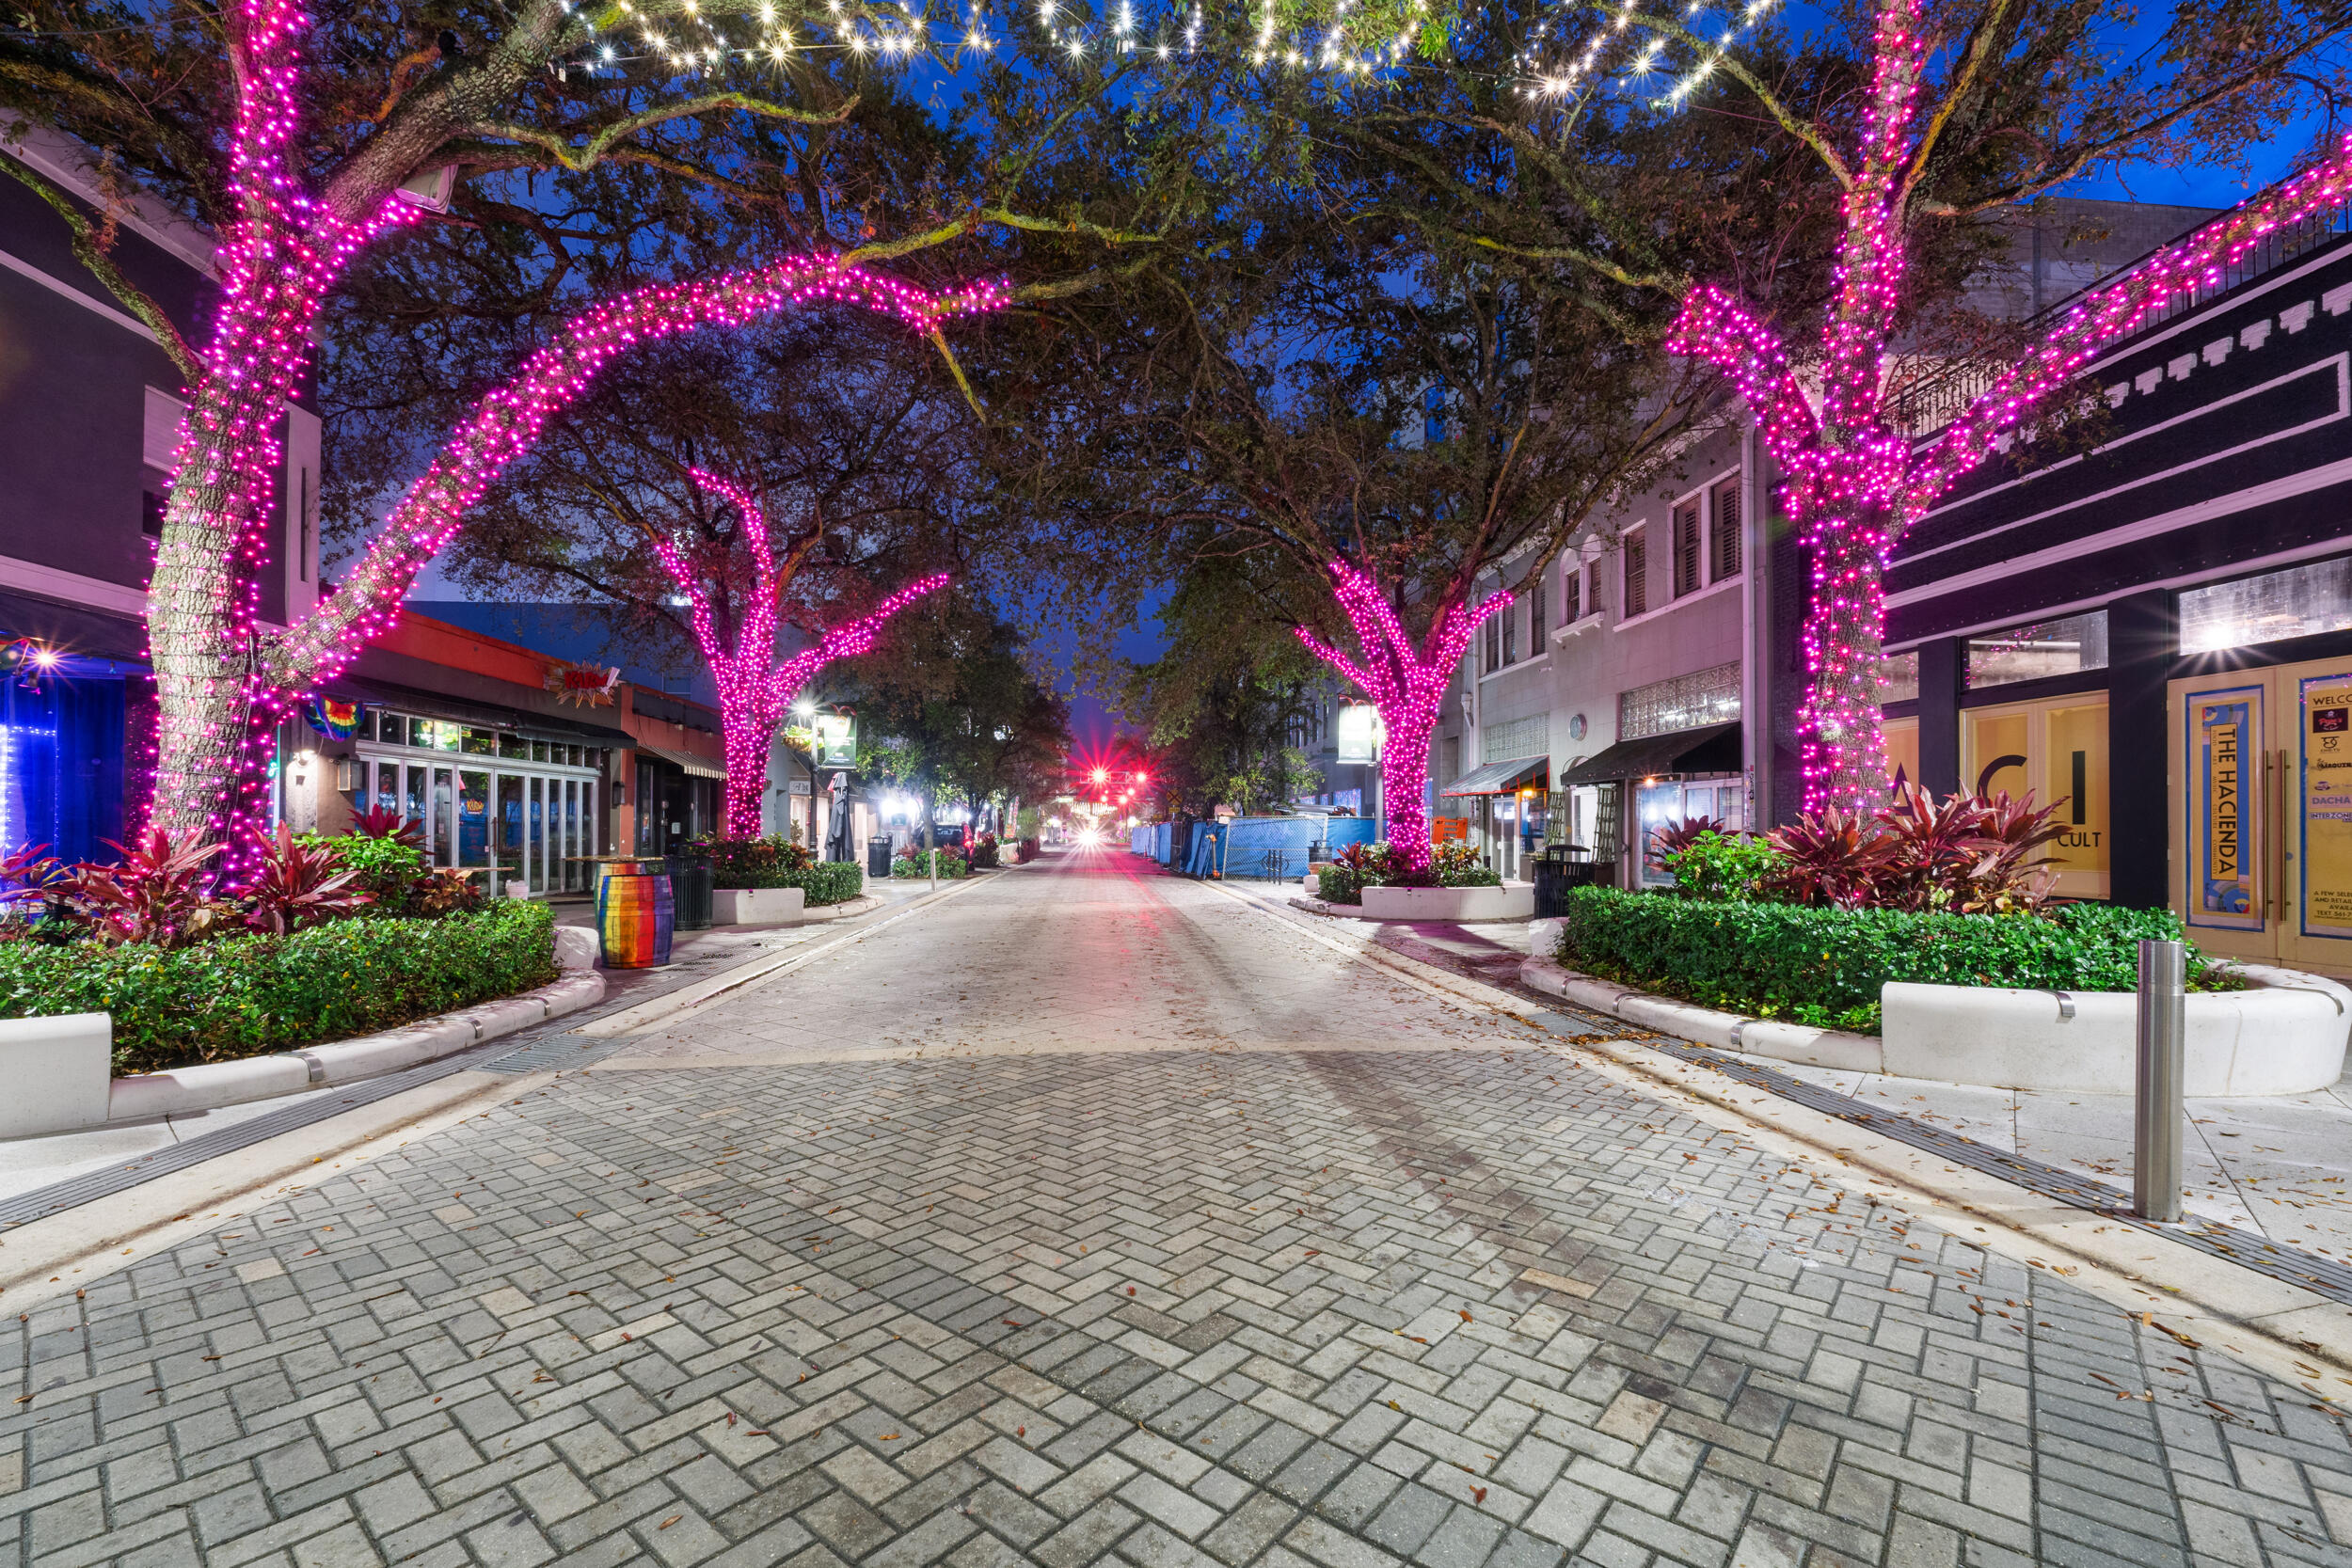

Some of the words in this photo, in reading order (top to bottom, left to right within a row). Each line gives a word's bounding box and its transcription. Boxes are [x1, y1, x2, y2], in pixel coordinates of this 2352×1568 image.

[2218, 728, 2236, 763] THE
[2312, 797, 2351, 805] DACHA
[2217, 769, 2237, 874] HACIENDA
[2057, 832, 2102, 847] CULT
